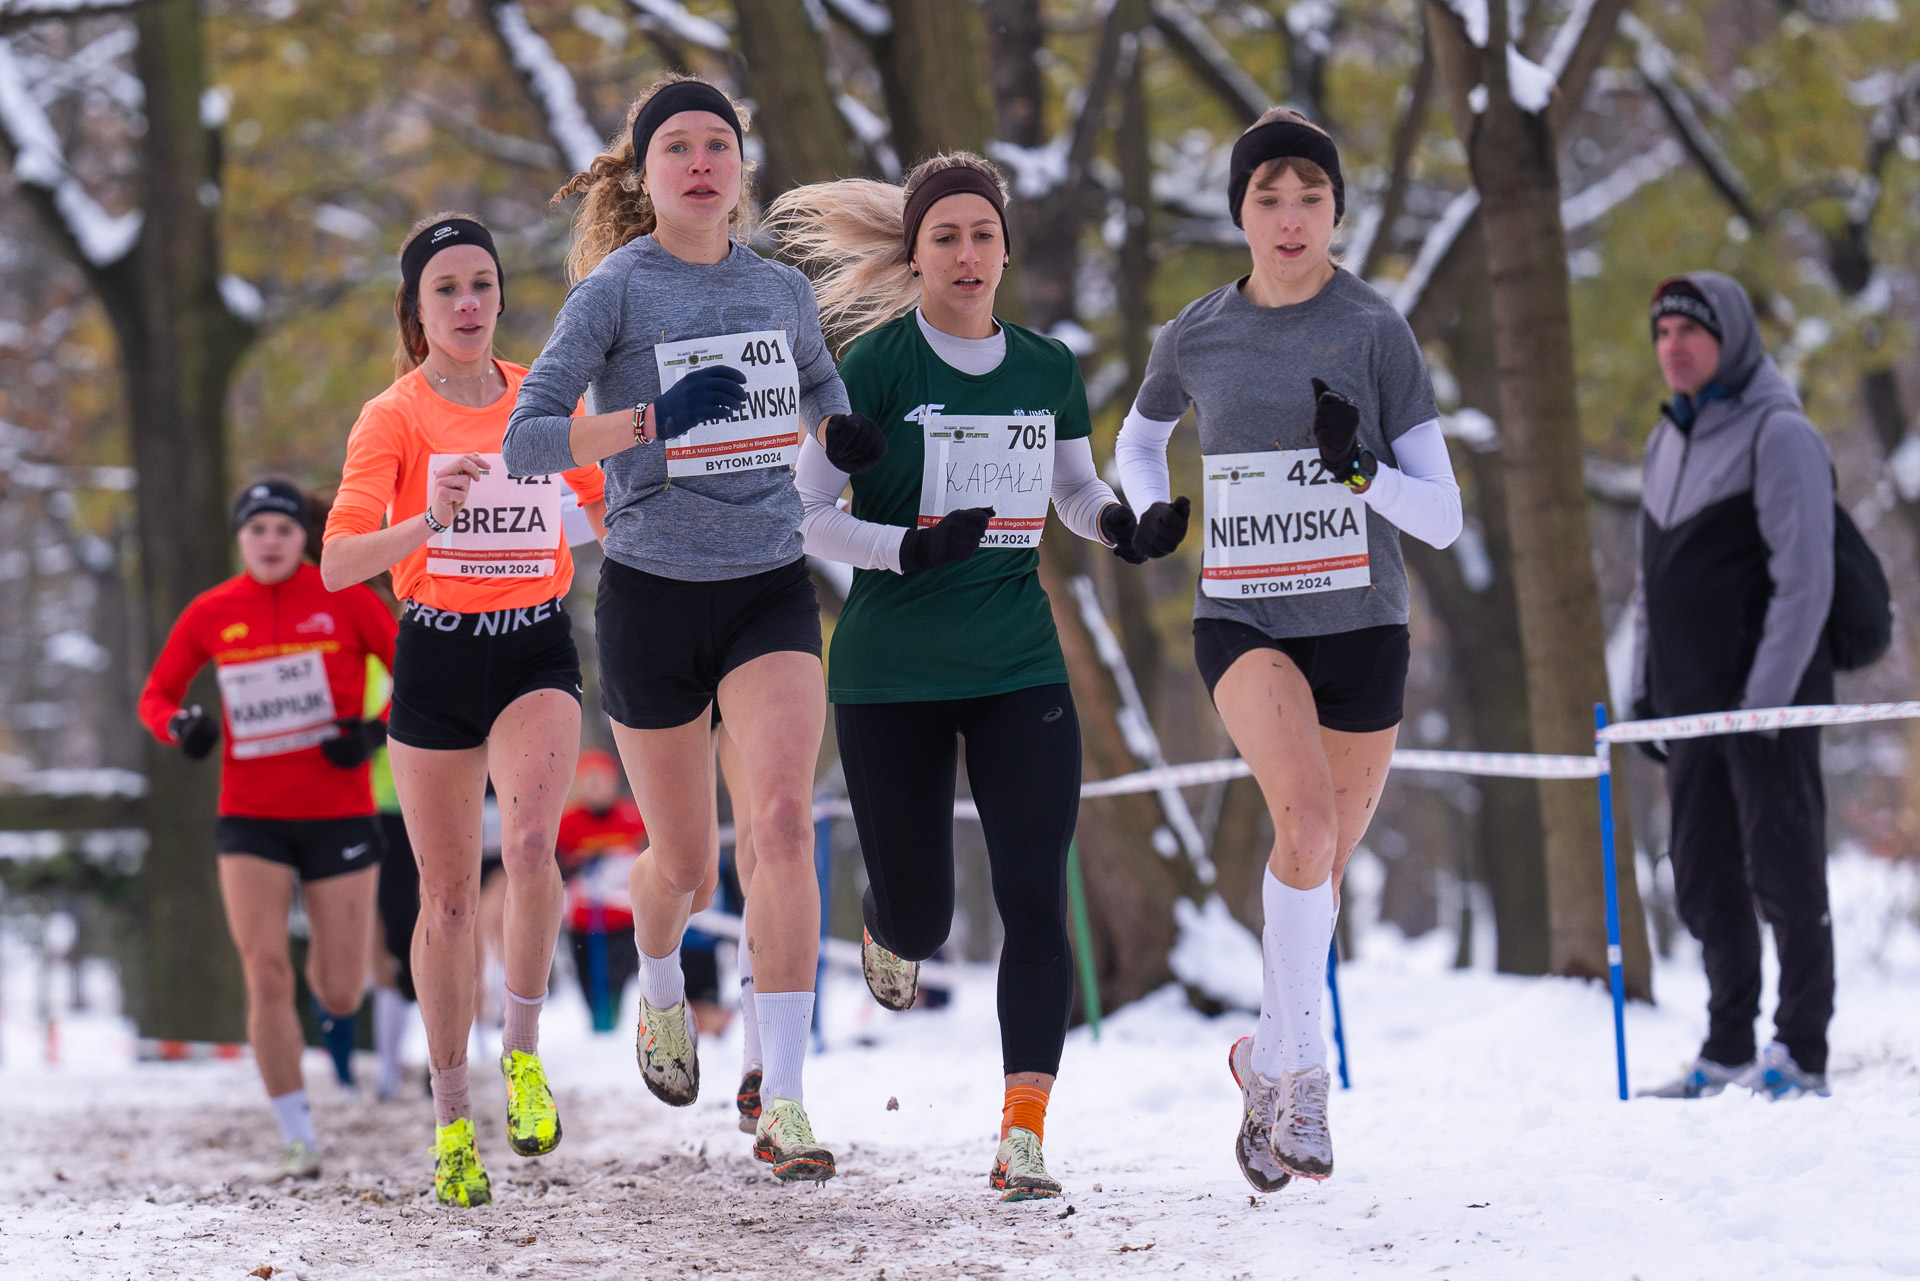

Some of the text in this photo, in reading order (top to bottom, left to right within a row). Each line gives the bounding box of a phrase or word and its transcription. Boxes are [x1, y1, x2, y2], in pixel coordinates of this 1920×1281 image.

[741, 339, 785, 366] 401
[697, 444, 732, 454] Mistrzostwa
[1007, 425, 1047, 450] 705
[706, 452, 782, 471] BYTOM 2024
[1287, 458, 1341, 486] 42
[946, 463, 1043, 494] KAPAŁA
[453, 506, 547, 533] BREZA
[1211, 507, 1359, 548] NIEMYJSKA
[1001, 535, 1030, 544] 2024
[461, 565, 539, 574] BYTOM 2024
[1241, 576, 1332, 594] BYTOM 2024
[473, 602, 551, 636] NIKE
